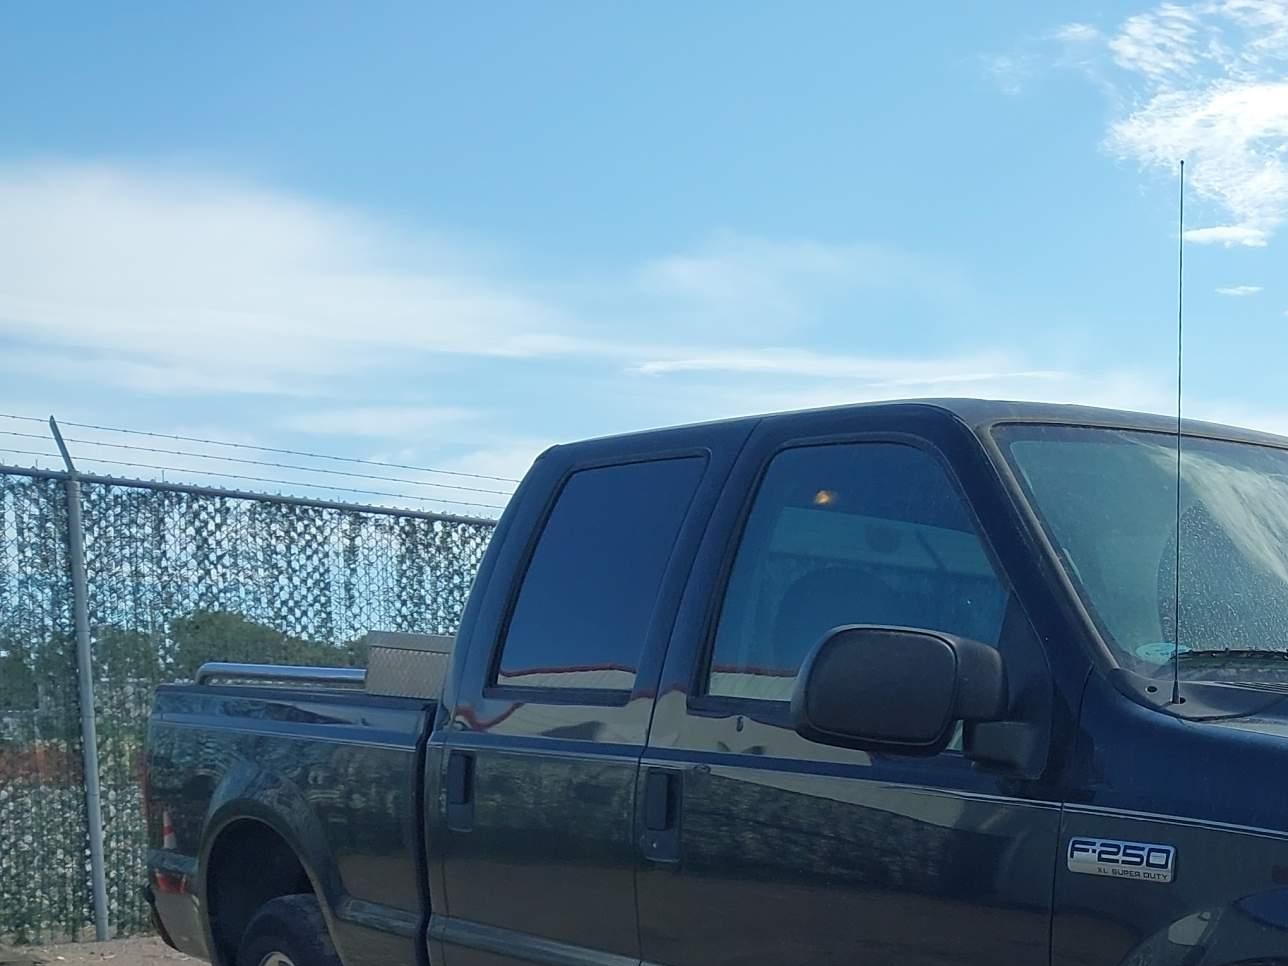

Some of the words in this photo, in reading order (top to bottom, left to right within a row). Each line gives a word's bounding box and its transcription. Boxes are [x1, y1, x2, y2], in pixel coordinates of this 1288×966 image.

[1070, 840, 1171, 870] F-250
[1112, 868, 1140, 877] SUPER
[1143, 871, 1168, 880] DUTY
